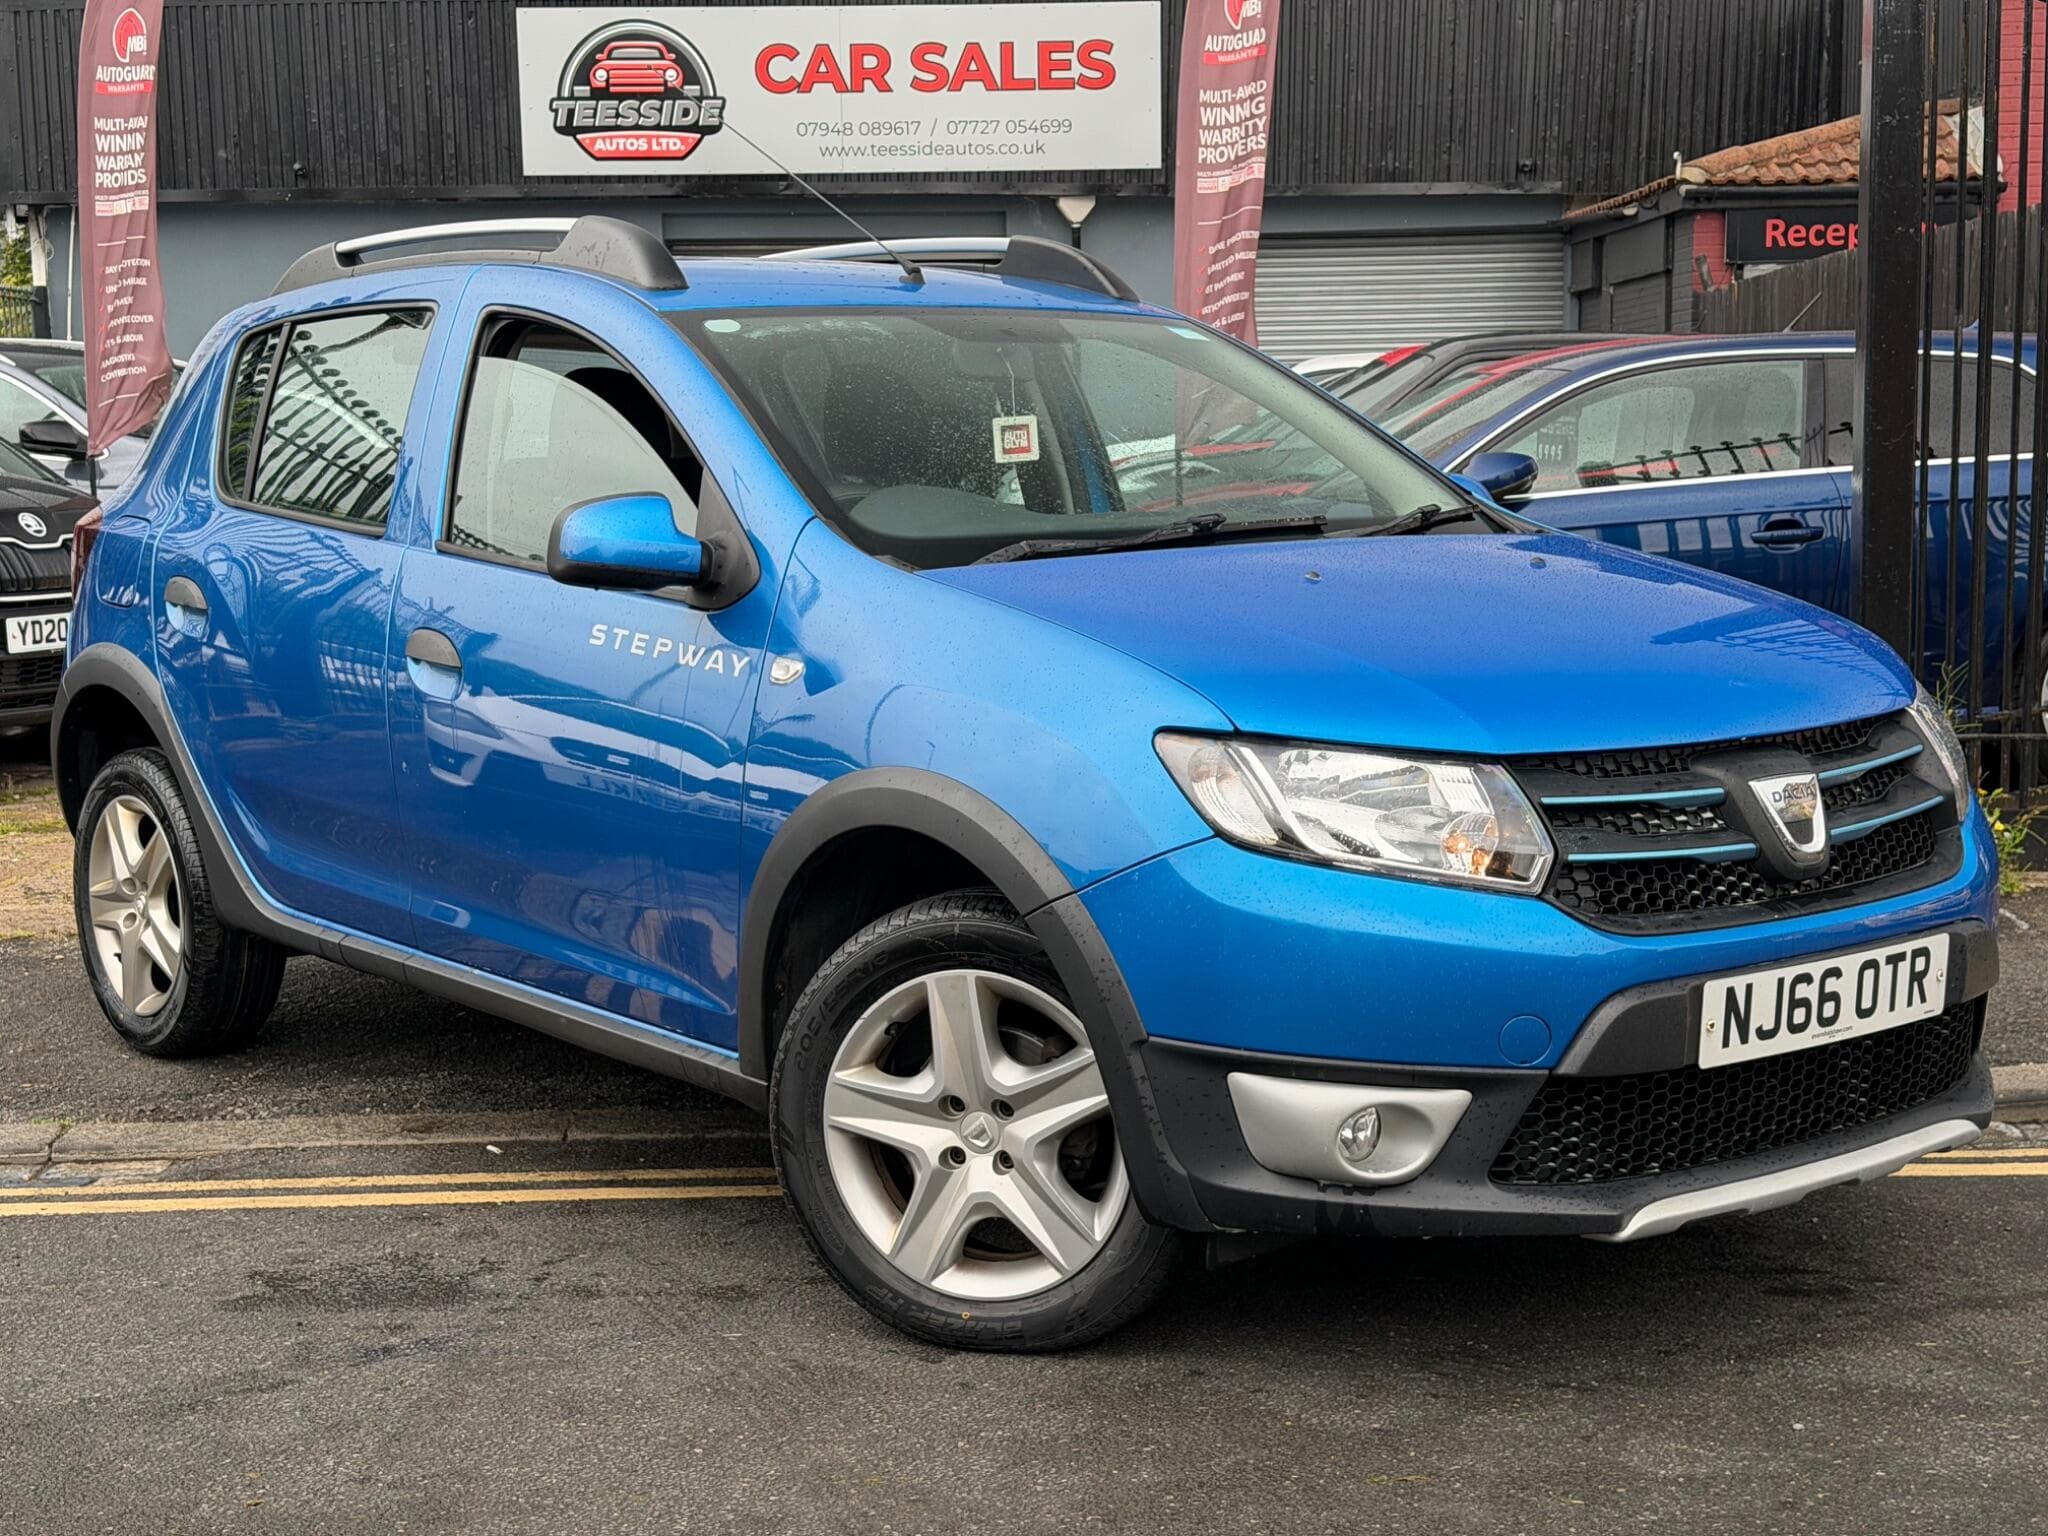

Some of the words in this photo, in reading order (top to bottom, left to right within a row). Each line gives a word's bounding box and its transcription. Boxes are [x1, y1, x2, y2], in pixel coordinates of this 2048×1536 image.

[753, 42, 893, 94] CAR
[910, 40, 1117, 93] SALES
[551, 99, 724, 128] TEESSIDE
[796, 121, 854, 137] 07948
[858, 120, 921, 136] 089617
[930, 119, 938, 137] /
[946, 119, 1000, 135] 07727
[1005, 118, 1073, 134] 054699
[593, 138, 649, 152] AUTOS
[651, 138, 685, 152] LTD.
[819, 140, 1046, 160] www.teessideautos.co.uk
[17, 617, 68, 647] YD20
[589, 623, 750, 678] STEPWAY
[1771, 783, 1816, 803] DACIA
[1721, 966, 1843, 1049] NJ66
[1854, 945, 1932, 1020] OTR
